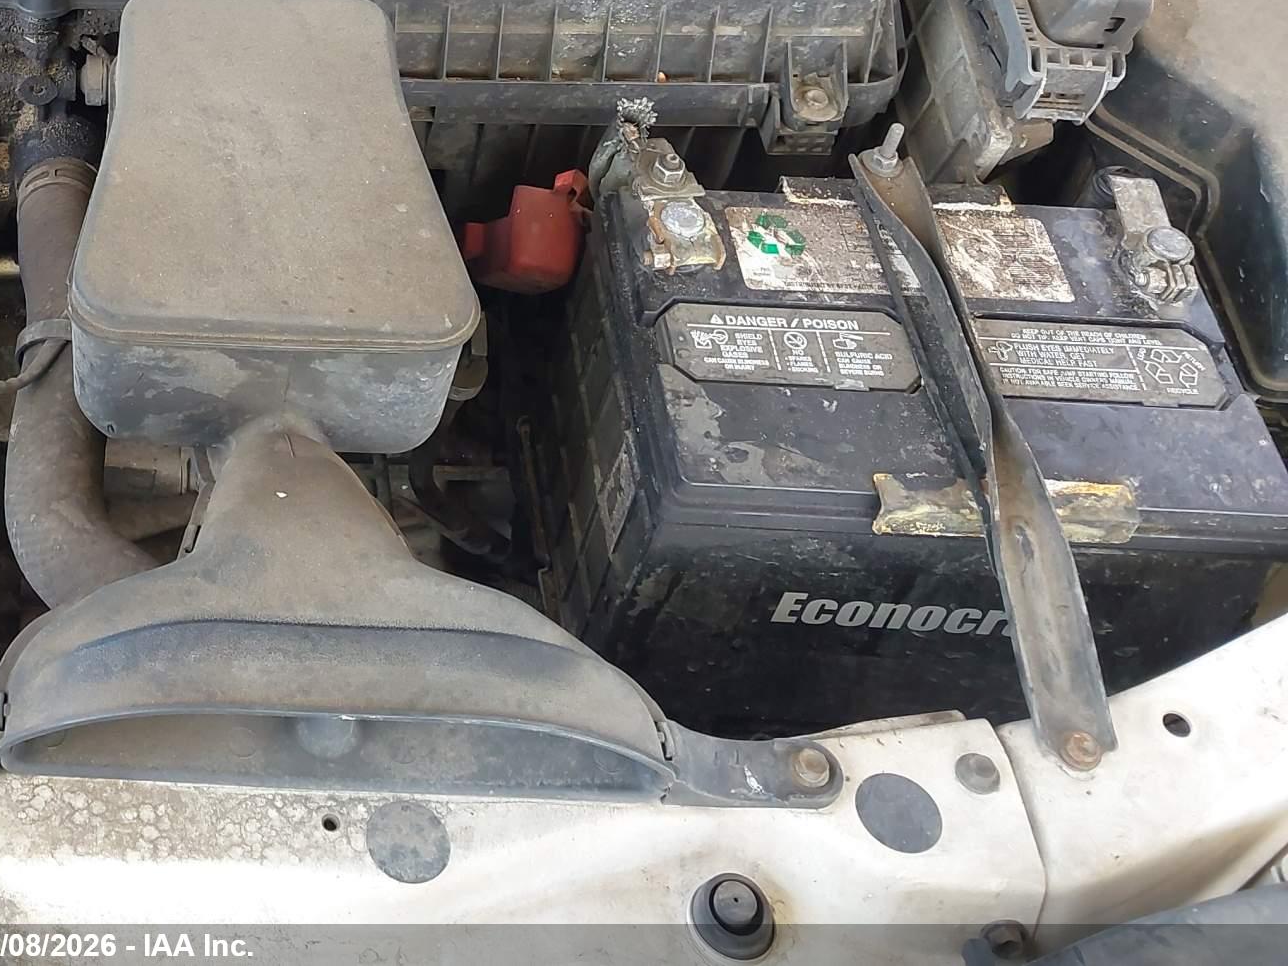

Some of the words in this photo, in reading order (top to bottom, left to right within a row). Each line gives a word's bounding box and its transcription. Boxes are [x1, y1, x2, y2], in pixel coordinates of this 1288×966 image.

[725, 315, 788, 328] DANGER
[802, 318, 860, 330] POISON
[735, 332, 763, 340] SHIELD
[720, 345, 764, 353] EXPLOSIVE
[1040, 344, 1062, 352] EYES
[1063, 345, 1114, 354] IMMEDIATELY
[834, 351, 873, 359] SULFURIC
[1069, 352, 1086, 360] GET
[1019, 357, 1055, 365] MEDICAL
[1055, 358, 1076, 366] HELP
[1166, 387, 1200, 395] RECYCLE
[770, 591, 1012, 638] Econocr
